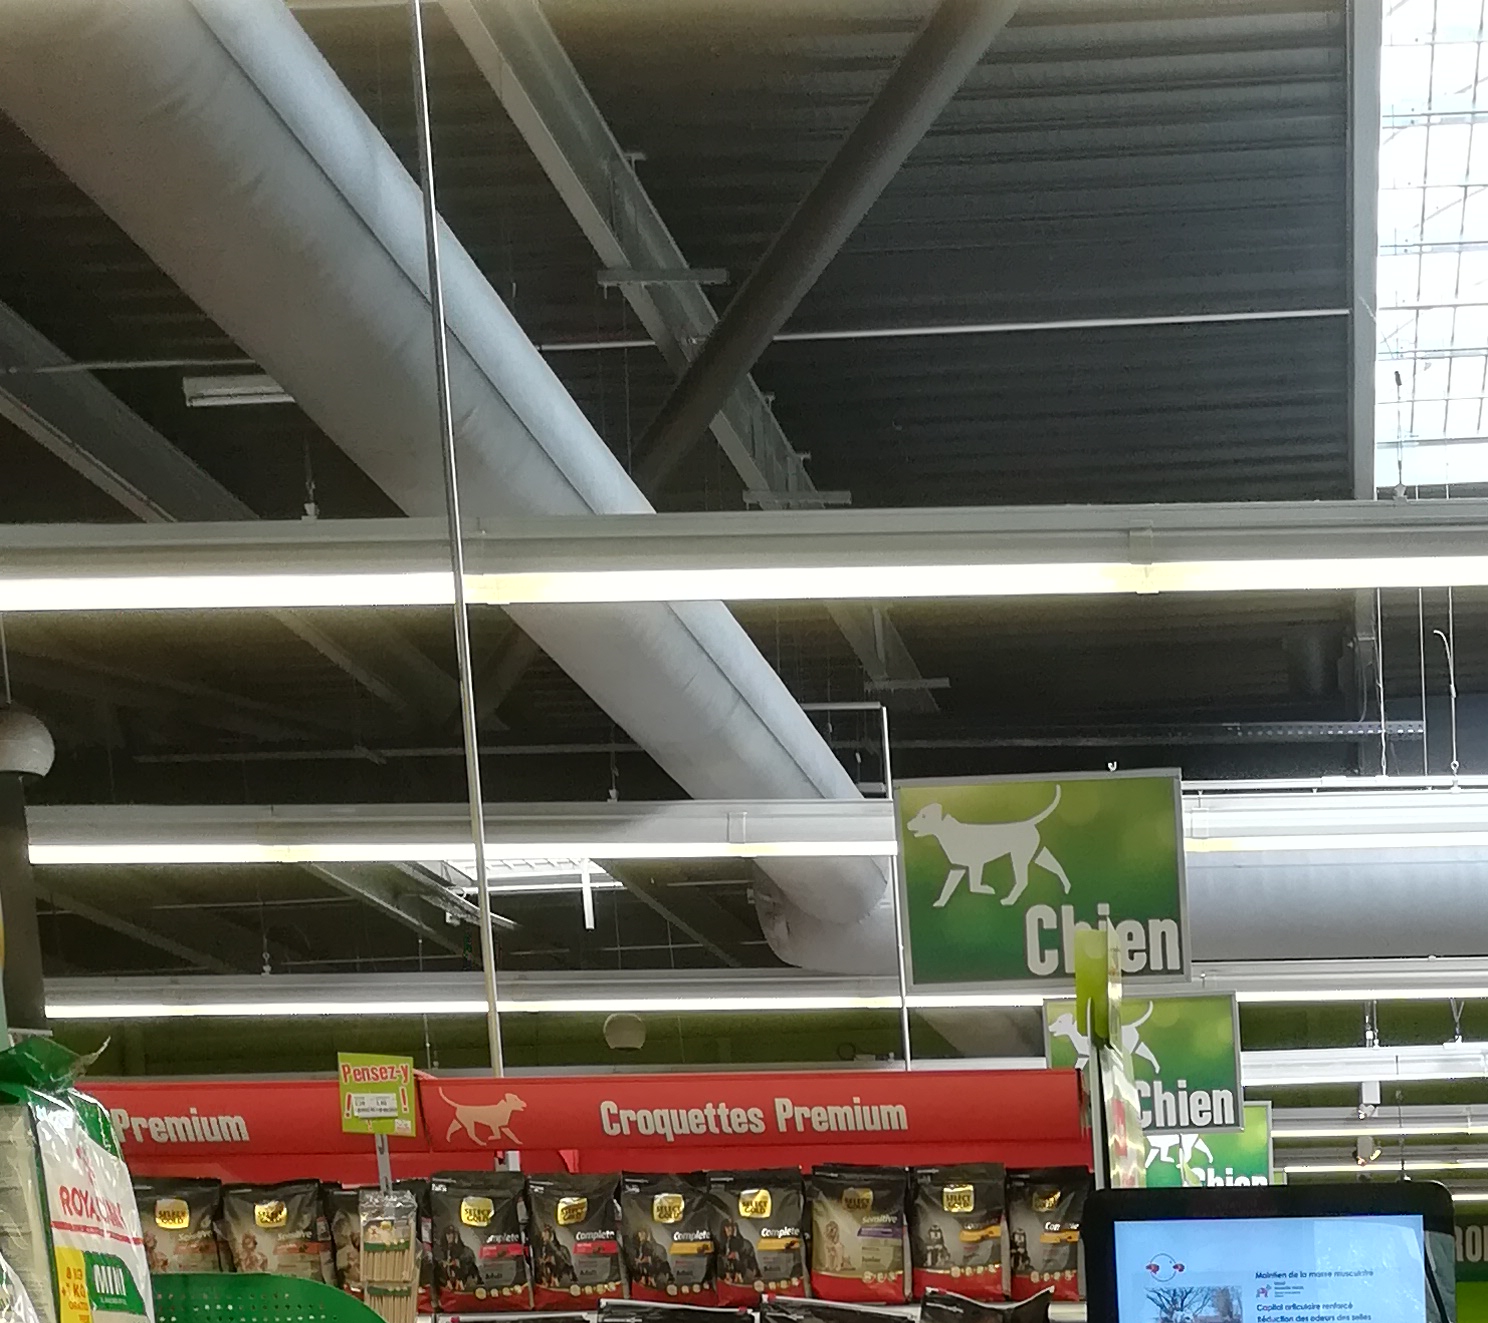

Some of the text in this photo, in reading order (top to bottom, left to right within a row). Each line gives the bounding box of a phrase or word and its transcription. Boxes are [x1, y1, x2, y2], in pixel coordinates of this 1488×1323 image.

[341, 1063, 409, 1084] Pensez-y
[113, 1108, 250, 1143] Premium
[600, 1098, 908, 1142] Croquettes Premium
[1257, 1301, 1353, 1312] Capital articulaire renforcé
[1257, 1314, 1294, 1323] Réduction
[1310, 1314, 1335, 1322] odeurs
[1351, 1313, 1372, 1321] selles
